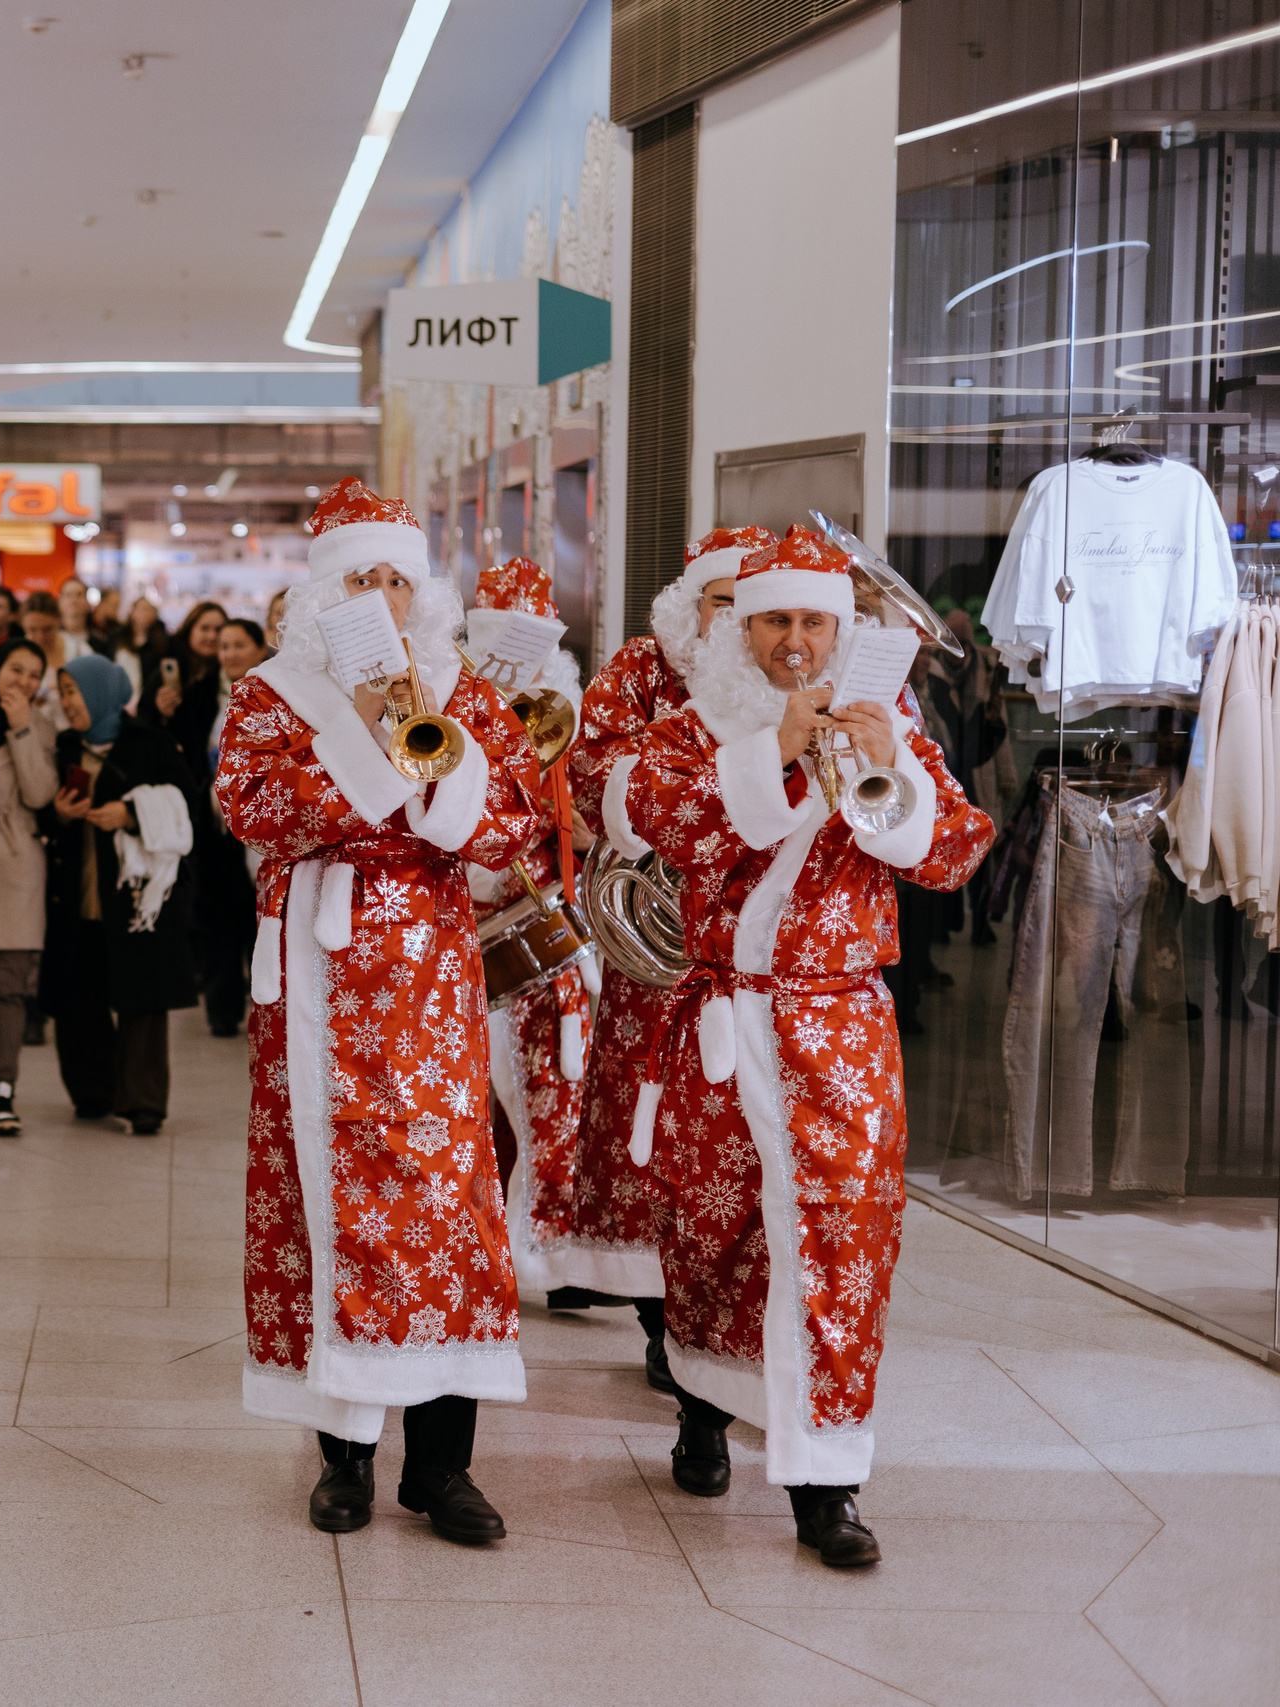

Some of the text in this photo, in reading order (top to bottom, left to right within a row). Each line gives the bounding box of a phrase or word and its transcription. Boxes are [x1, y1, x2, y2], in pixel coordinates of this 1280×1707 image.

[408, 316, 519, 347] ЛИФТ
[1068, 530, 1186, 568] Timeless Journey
